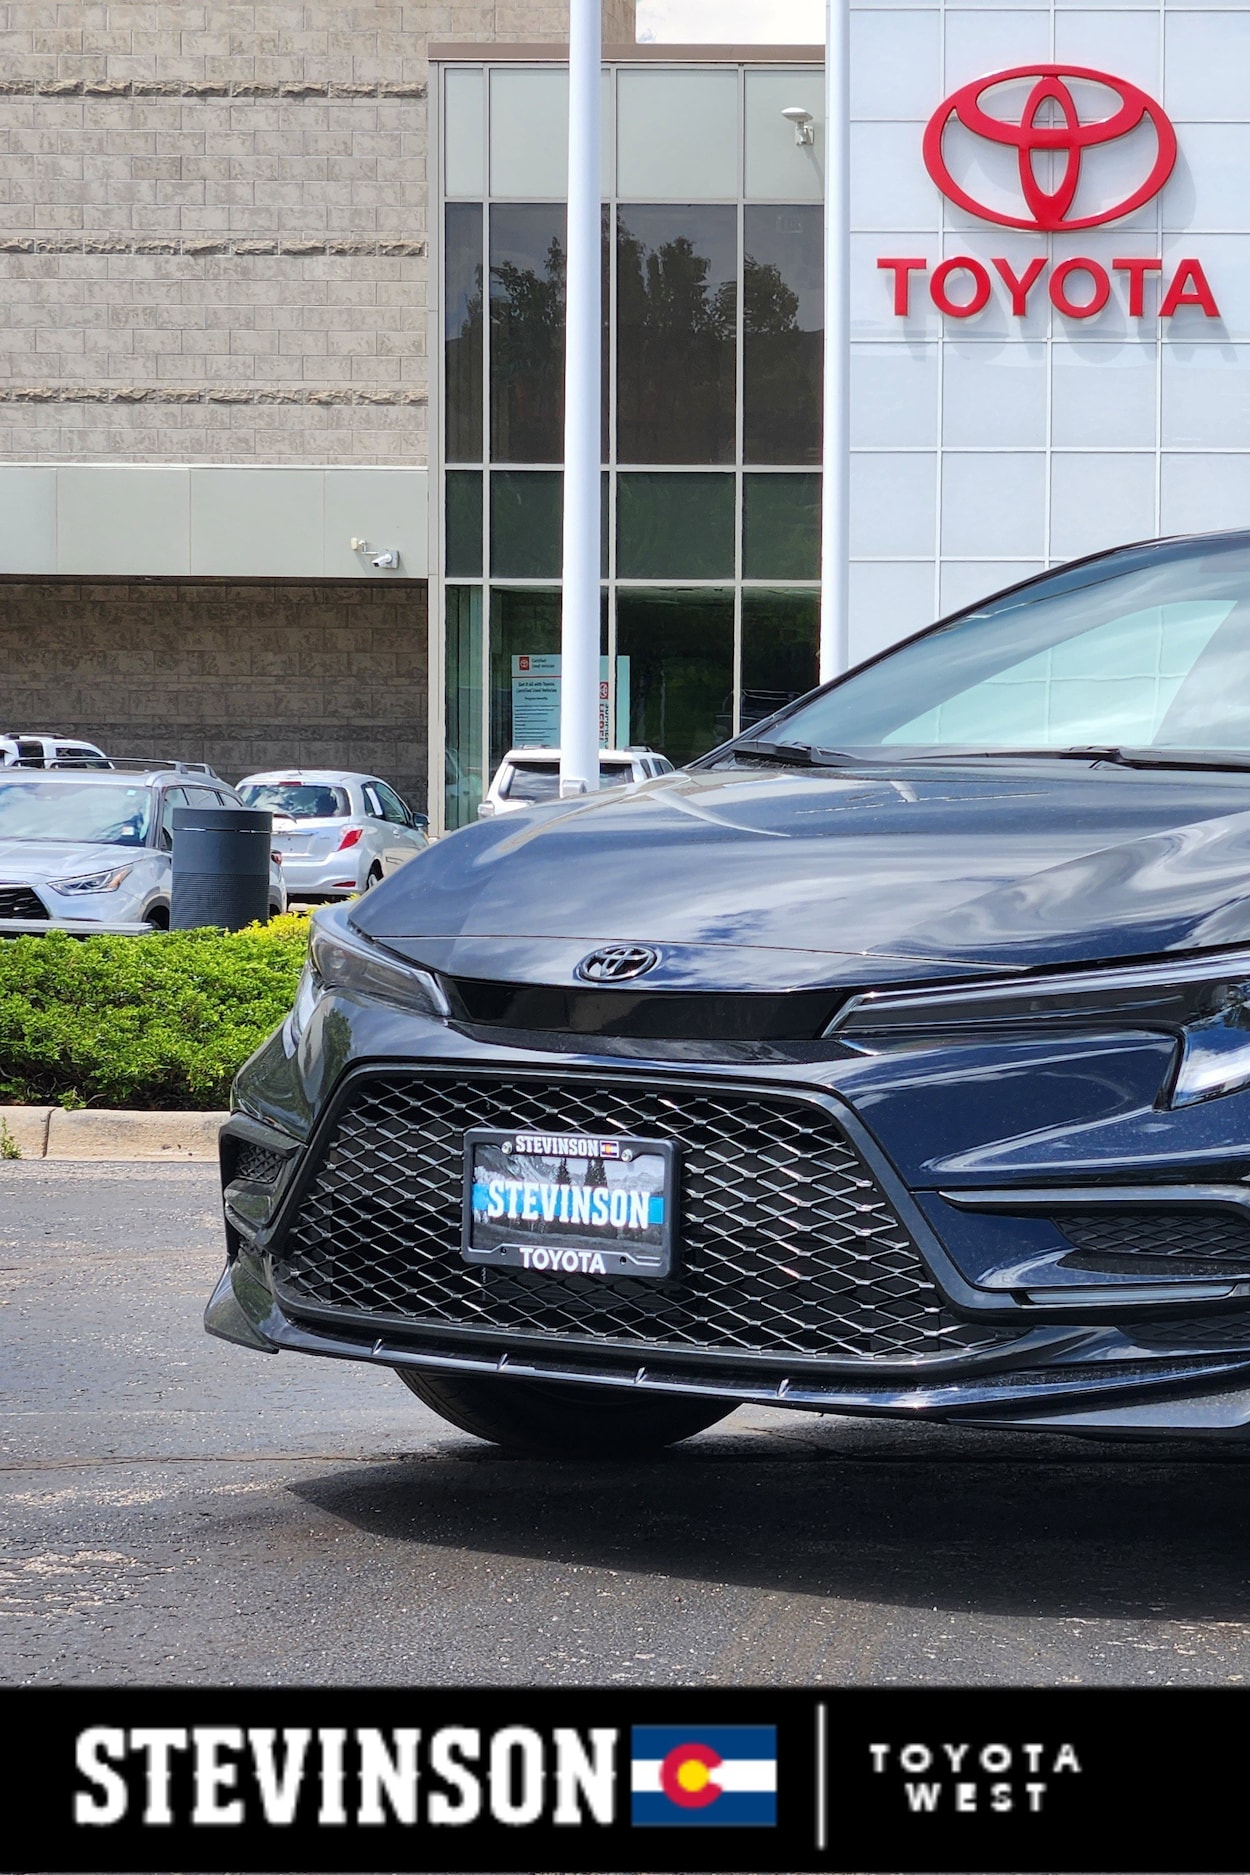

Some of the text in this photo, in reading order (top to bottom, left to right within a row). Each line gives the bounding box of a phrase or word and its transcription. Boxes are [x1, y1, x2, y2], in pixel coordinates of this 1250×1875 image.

[877, 256, 1220, 319] TOYOTA
[515, 1135, 600, 1157] STEVINSON
[487, 1180, 650, 1229] STEVINSON
[519, 1247, 606, 1274] TOYOTA
